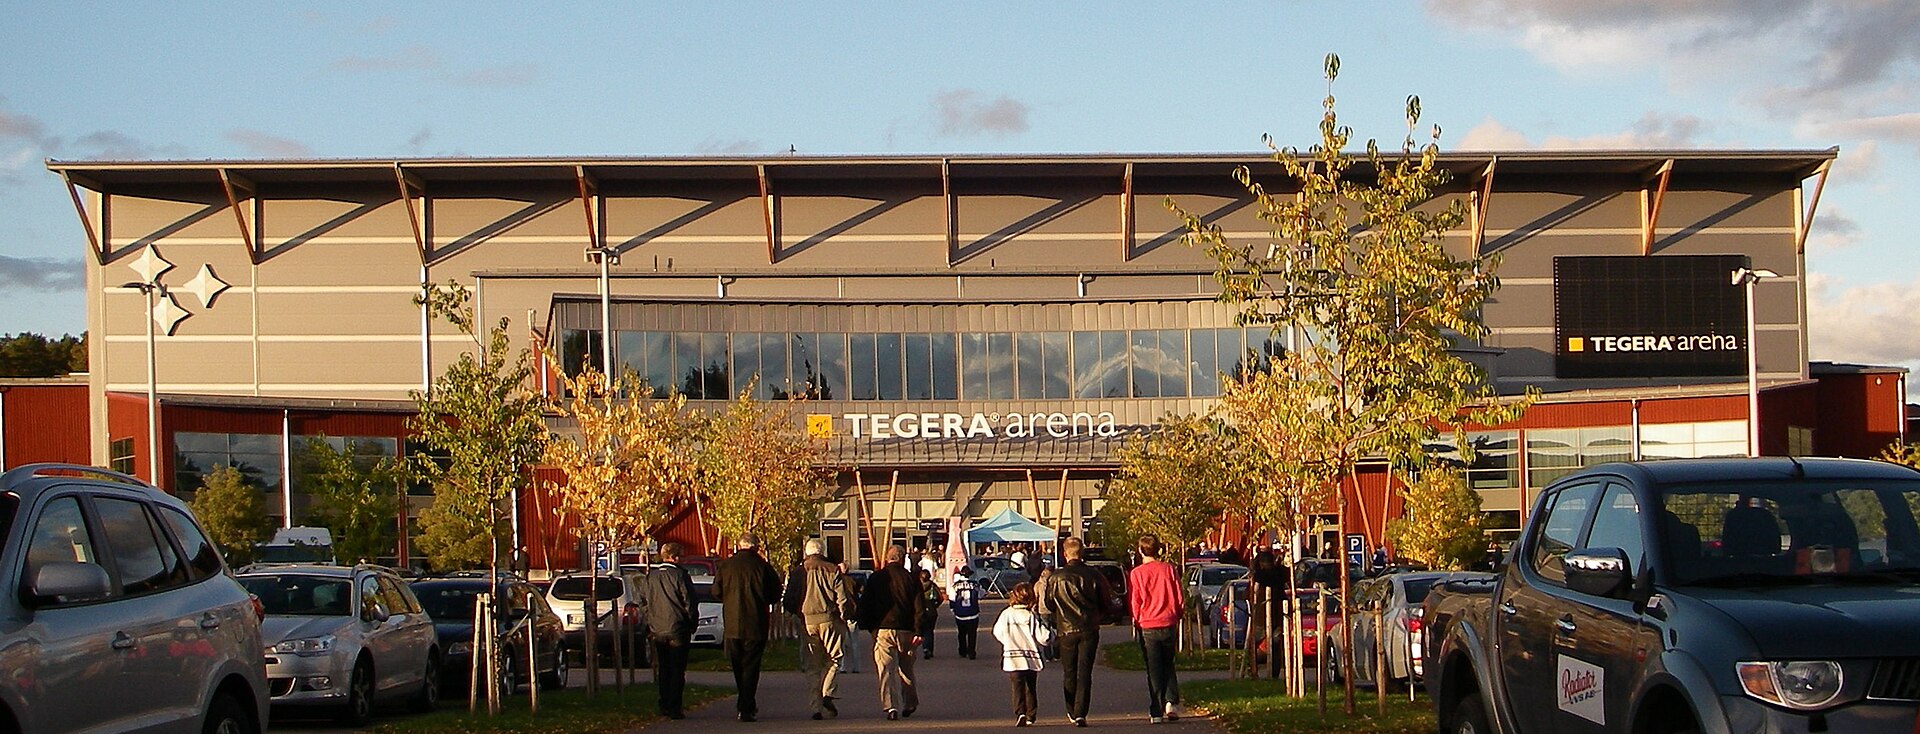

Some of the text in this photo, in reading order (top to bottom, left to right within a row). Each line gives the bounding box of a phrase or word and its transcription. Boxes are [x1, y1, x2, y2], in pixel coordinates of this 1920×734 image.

[1677, 334, 1738, 351] arena
[1006, 411, 1119, 438] arena
[1350, 538, 1360, 550] P
